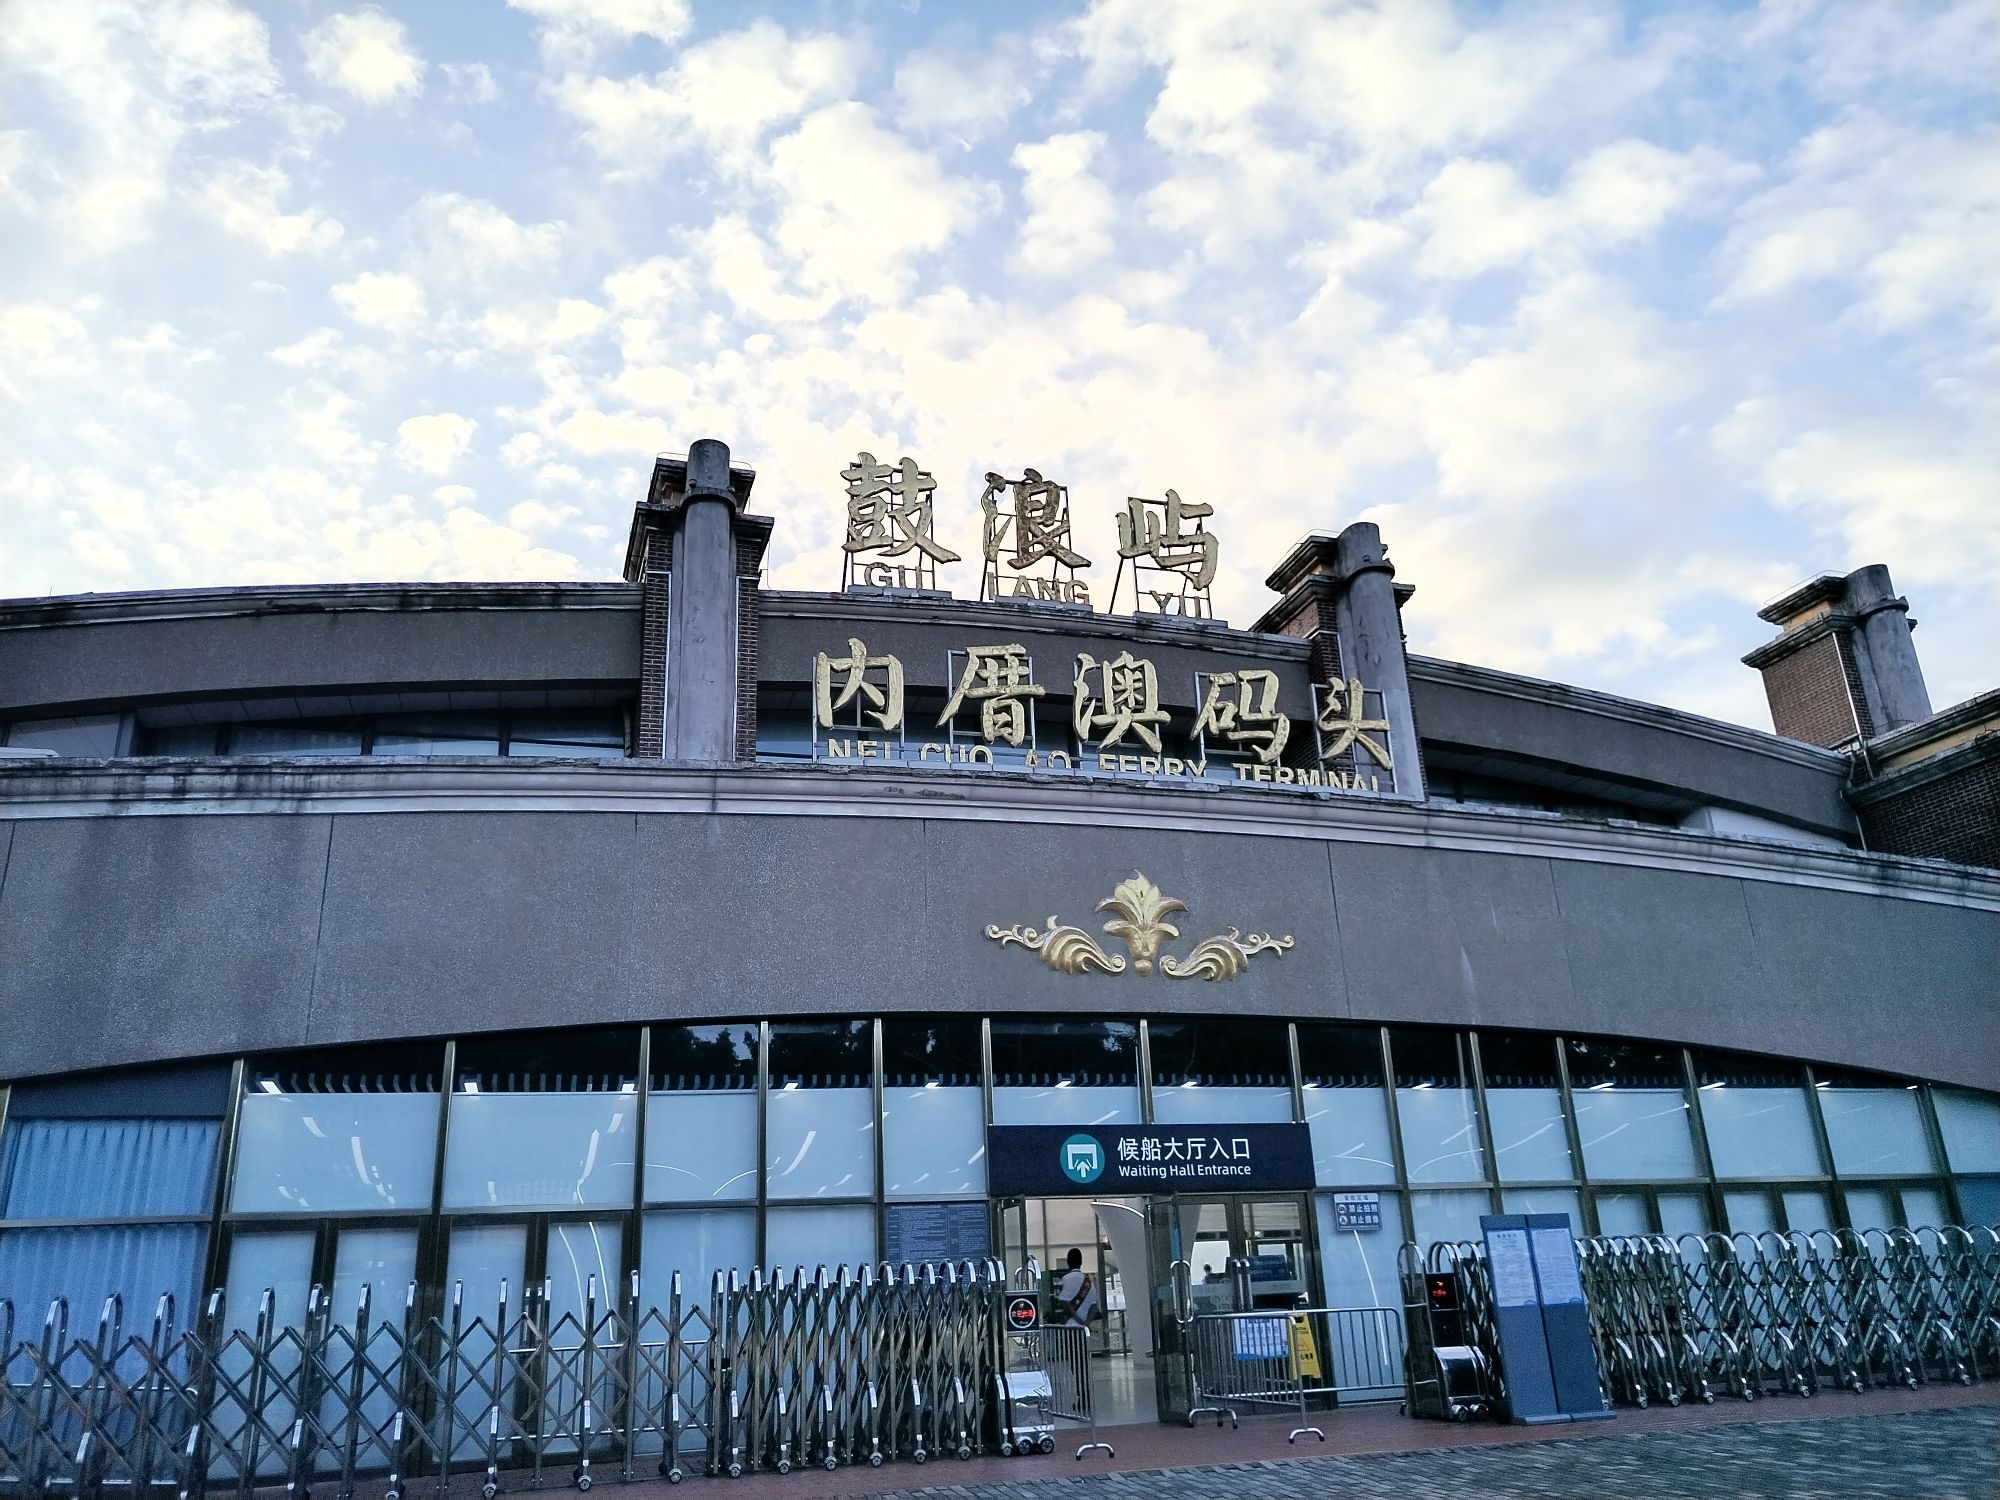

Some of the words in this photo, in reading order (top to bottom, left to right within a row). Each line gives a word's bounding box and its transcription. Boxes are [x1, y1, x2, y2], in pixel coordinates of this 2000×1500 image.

[840, 451, 1219, 591] 鼓浪屿
[864, 562, 922, 590] GU
[1150, 590, 1201, 618] YU
[817, 638, 1392, 770] 内厝澳码头
[828, 739, 891, 760] NEI
[1024, 748, 1072, 769] AO
[1099, 754, 1207, 778] FERRY
[1117, 1136, 1251, 1161] 候船大厅入口
[1118, 1164, 1167, 1179] Waiting
[1169, 1163, 1195, 1176] Hall
[1197, 1163, 1251, 1176] Entrance
